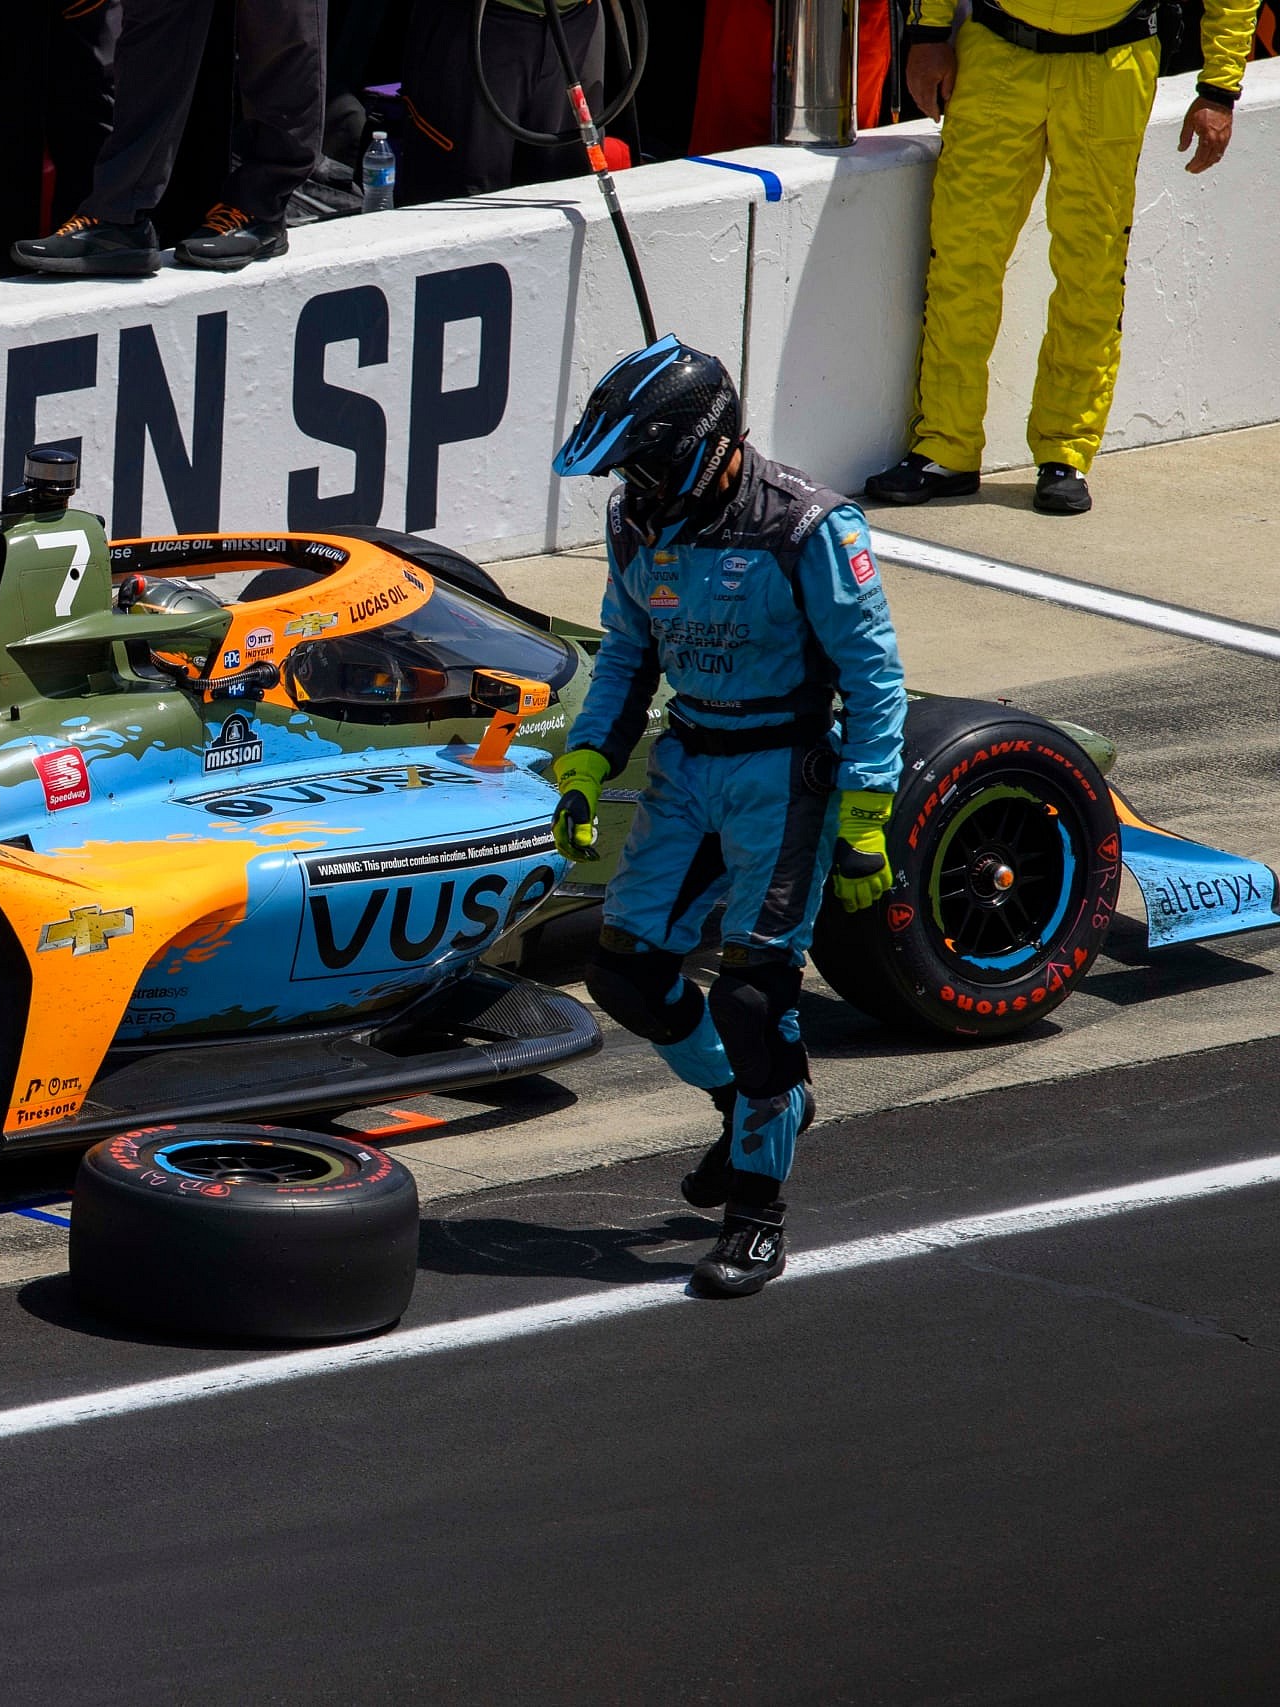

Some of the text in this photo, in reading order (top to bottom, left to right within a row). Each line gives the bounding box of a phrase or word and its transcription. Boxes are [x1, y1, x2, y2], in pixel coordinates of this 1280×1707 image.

[287, 262, 513, 533] SP
[691, 435, 731, 498] BRENDON
[790, 504, 823, 544] sparco
[150, 540, 214, 553] LUCAS OIL
[222, 539, 287, 552] mission
[33, 529, 91, 617] 7
[349, 585, 409, 624] LUCAS OIL
[257, 634, 272, 644] NTT
[224, 651, 240, 667] PPG
[245, 647, 274, 659] INDYCAR
[206, 744, 261, 769] mission
[49, 789, 87, 805] Speedway
[908, 740, 1033, 849] FIREHAWK
[1037, 745, 1073, 769] INDY
[318, 861, 363, 876] WARNING:
[363, 859, 381, 872] This
[381, 858, 409, 872] product
[409, 854, 439, 867] contains
[439, 851, 467, 863] nicotine.
[468, 847, 493, 859] Nicotine
[493, 843, 500, 855] is
[500, 844, 508, 853] an
[508, 839, 532, 852] addictive
[1155, 873, 1261, 916] alteryx
[132, 986, 189, 999] stratasys
[940, 947, 1088, 1016] Firestone
[122, 1011, 176, 1025] AERO
[62, 1077, 80, 1090] NTT
[17, 1101, 78, 1125] Firestone
